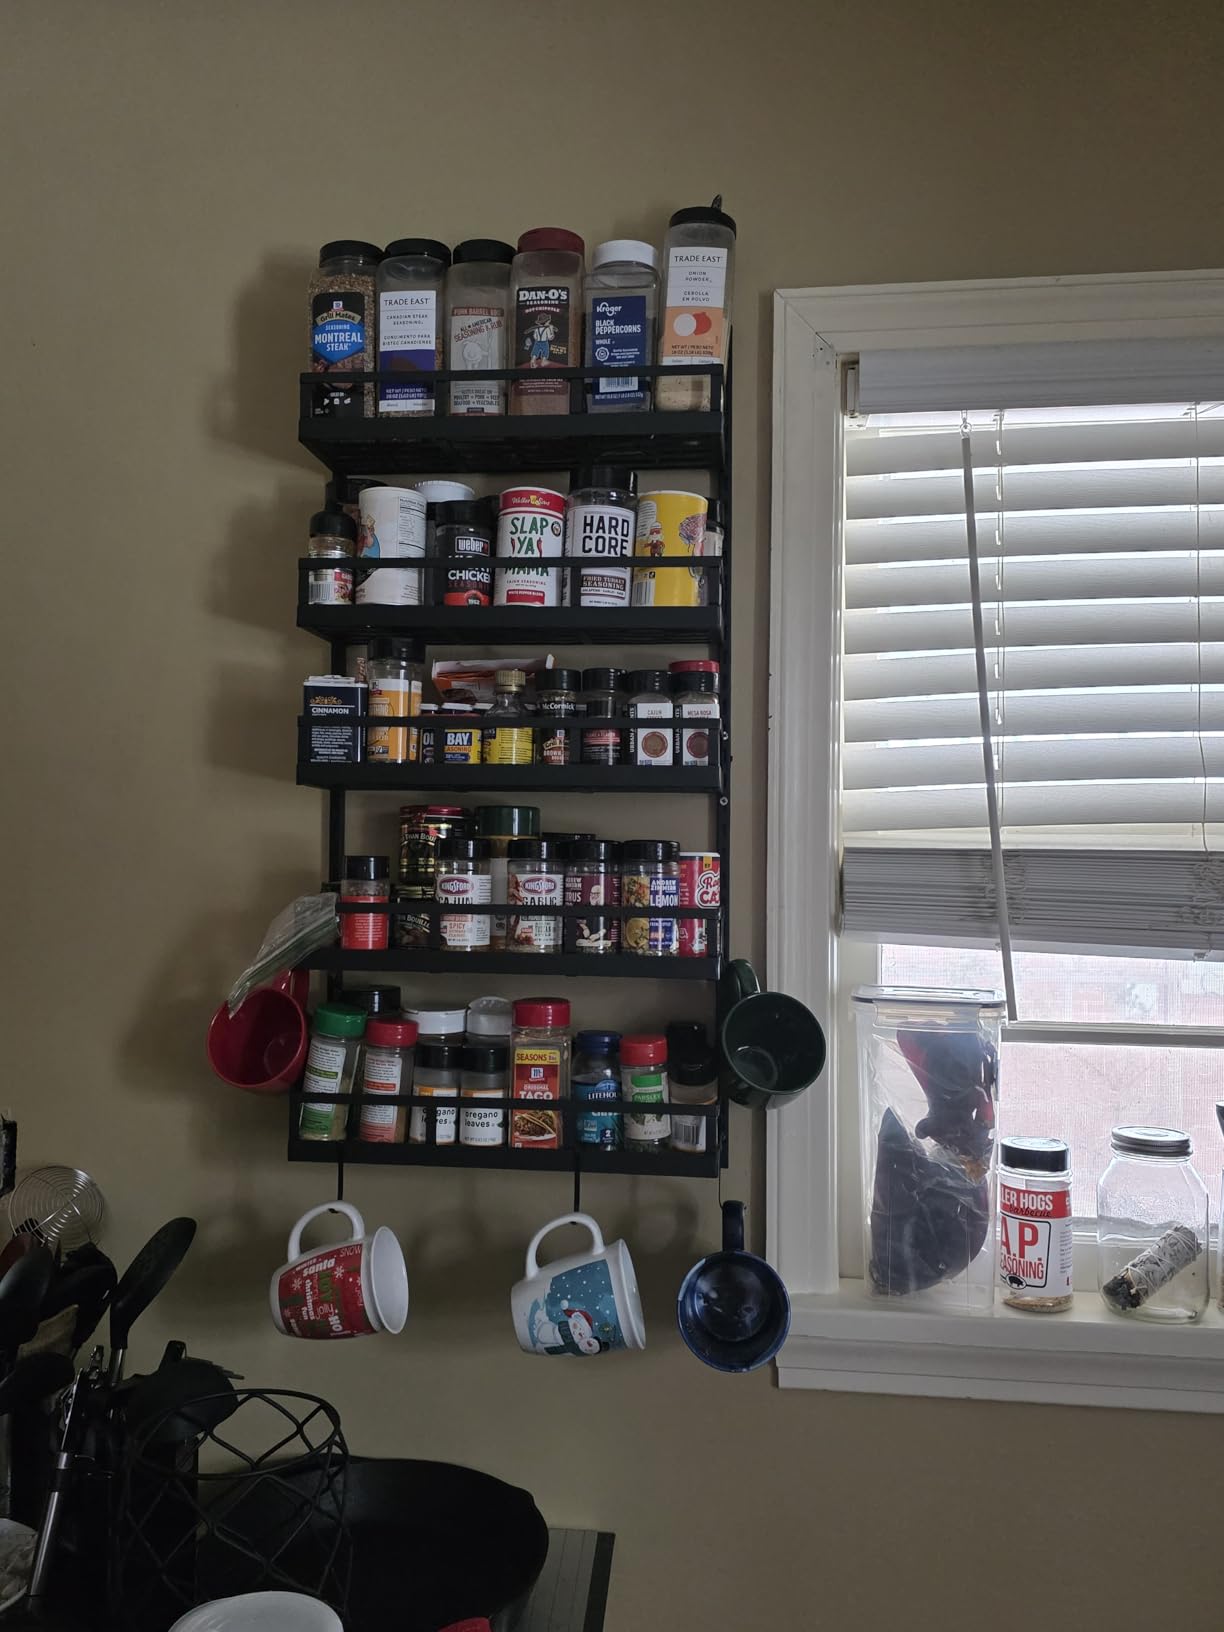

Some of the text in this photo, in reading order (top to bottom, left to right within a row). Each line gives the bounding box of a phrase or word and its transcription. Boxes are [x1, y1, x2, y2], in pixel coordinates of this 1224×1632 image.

[674, 255, 721, 263] TRADE EAST
[519, 289, 567, 301] DAN-O'S
[384, 299, 408, 307] TRADE
[597, 302, 622, 317] Kroger
[596, 319, 615, 328] BLACK
[596, 325, 642, 335] PEPPERCORNS
[314, 332, 363, 345] MONTREAL
[326, 343, 350, 352] STEAK
[510, 516, 548, 535] SLAP
[583, 515, 630, 538] HARD
[517, 536, 535, 555] YA
[582, 535, 628, 556] CORE
[583, 581, 625, 591] SEASONING
[312, 707, 349, 715] CINNAMON
[542, 702, 575, 711] McCormick
[447, 733, 469, 745] BAY
[523, 896, 557, 906] GARLIC
[650, 895, 679, 907] LEMON
[517, 1053, 547, 1062] SEASONS
[519, 1090, 553, 1100] TACO
[465, 1111, 498, 1120] oregano
[464, 1118, 490, 1127] leaves
[1020, 1193, 1053, 1210] HOGS
[1009, 1203, 1051, 1218] barbecue
[339, 1245, 362, 1257] SNOW
[303, 1257, 336, 1277] santa
[304, 1279, 316, 1320] christmas
[301, 1306, 309, 1320] fun
[328, 1315, 344, 1332] HO
